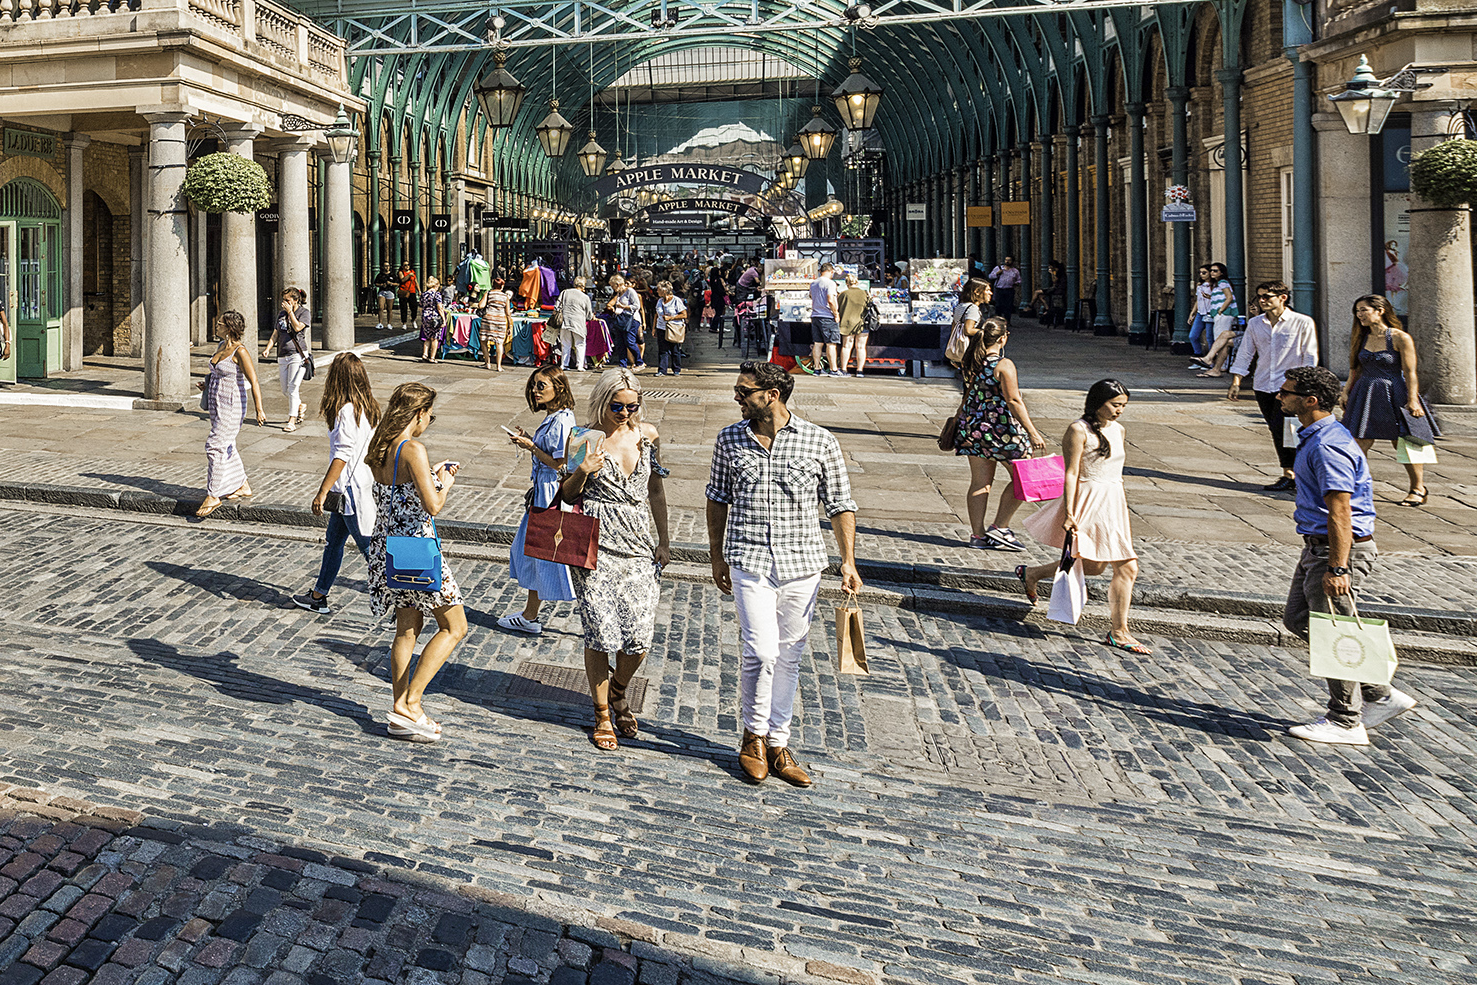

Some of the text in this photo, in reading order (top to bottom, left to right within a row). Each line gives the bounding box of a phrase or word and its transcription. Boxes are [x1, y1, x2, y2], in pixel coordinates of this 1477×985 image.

[616, 167, 743, 188] APPLE MARKET
[658, 200, 740, 212] APPLE MARKET
